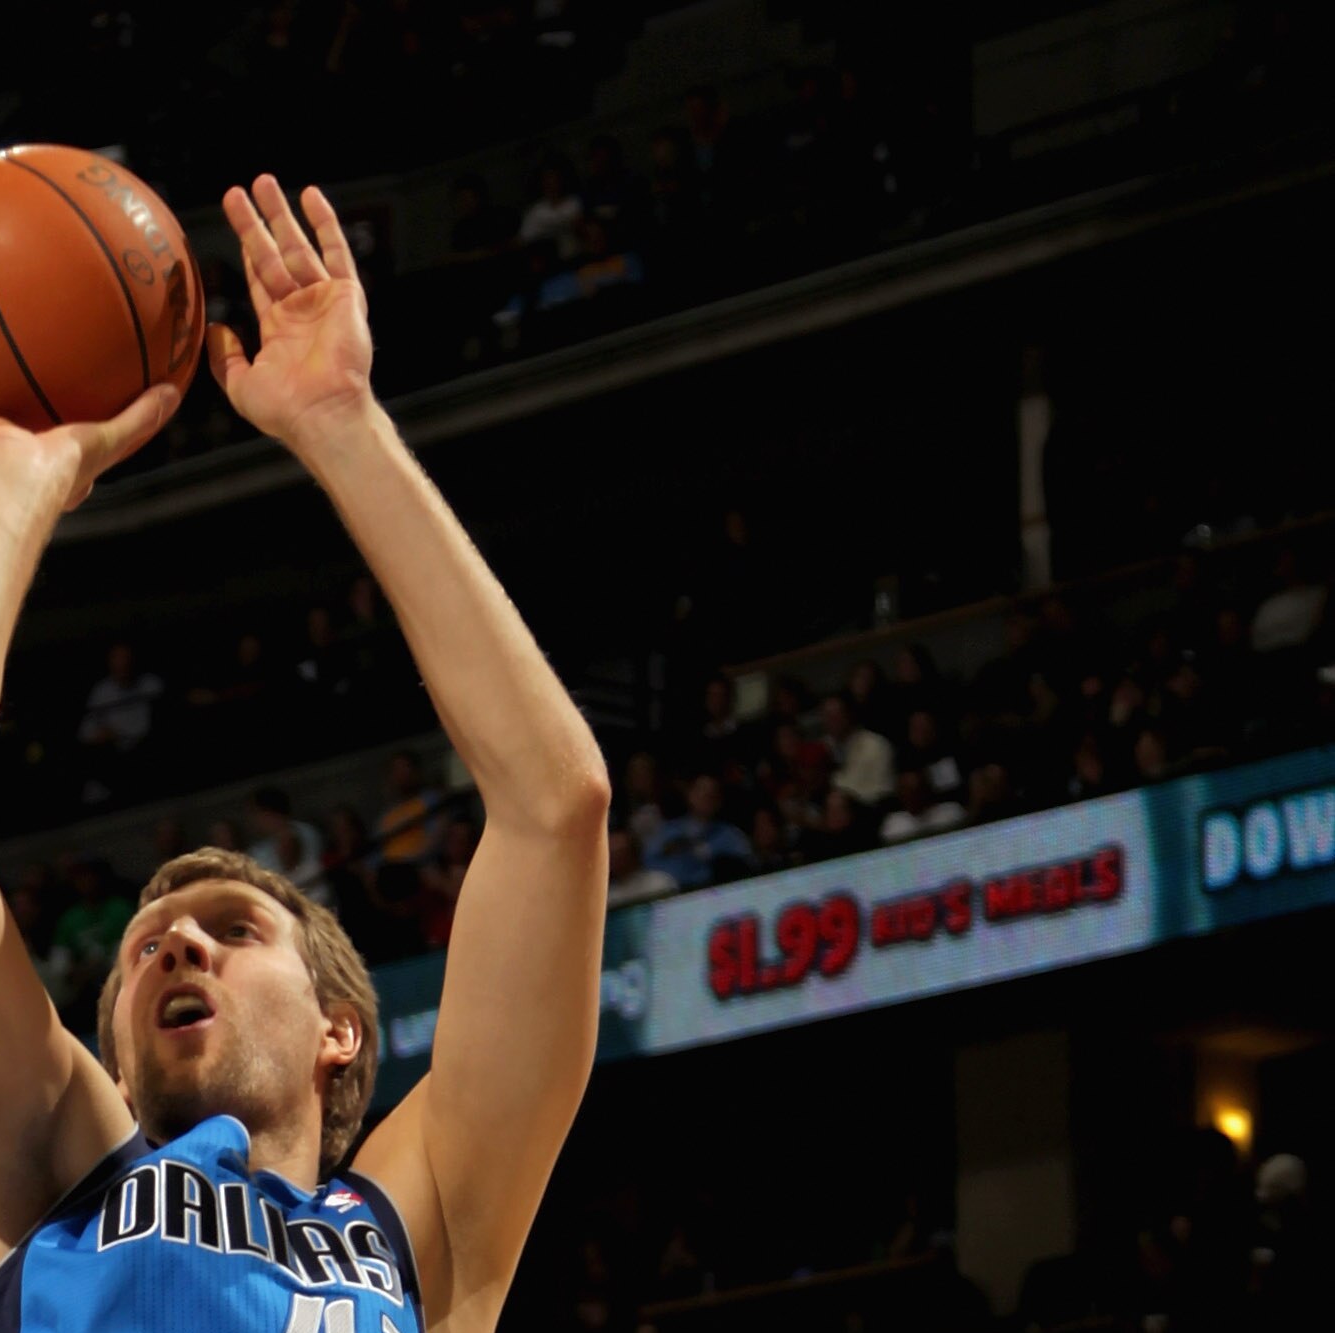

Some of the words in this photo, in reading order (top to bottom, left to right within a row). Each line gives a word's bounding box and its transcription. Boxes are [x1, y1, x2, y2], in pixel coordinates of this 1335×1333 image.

[706, 892, 861, 999] $1.99
[982, 843, 1125, 922] MEALS
[97, 1158, 404, 1308] DALLAS
